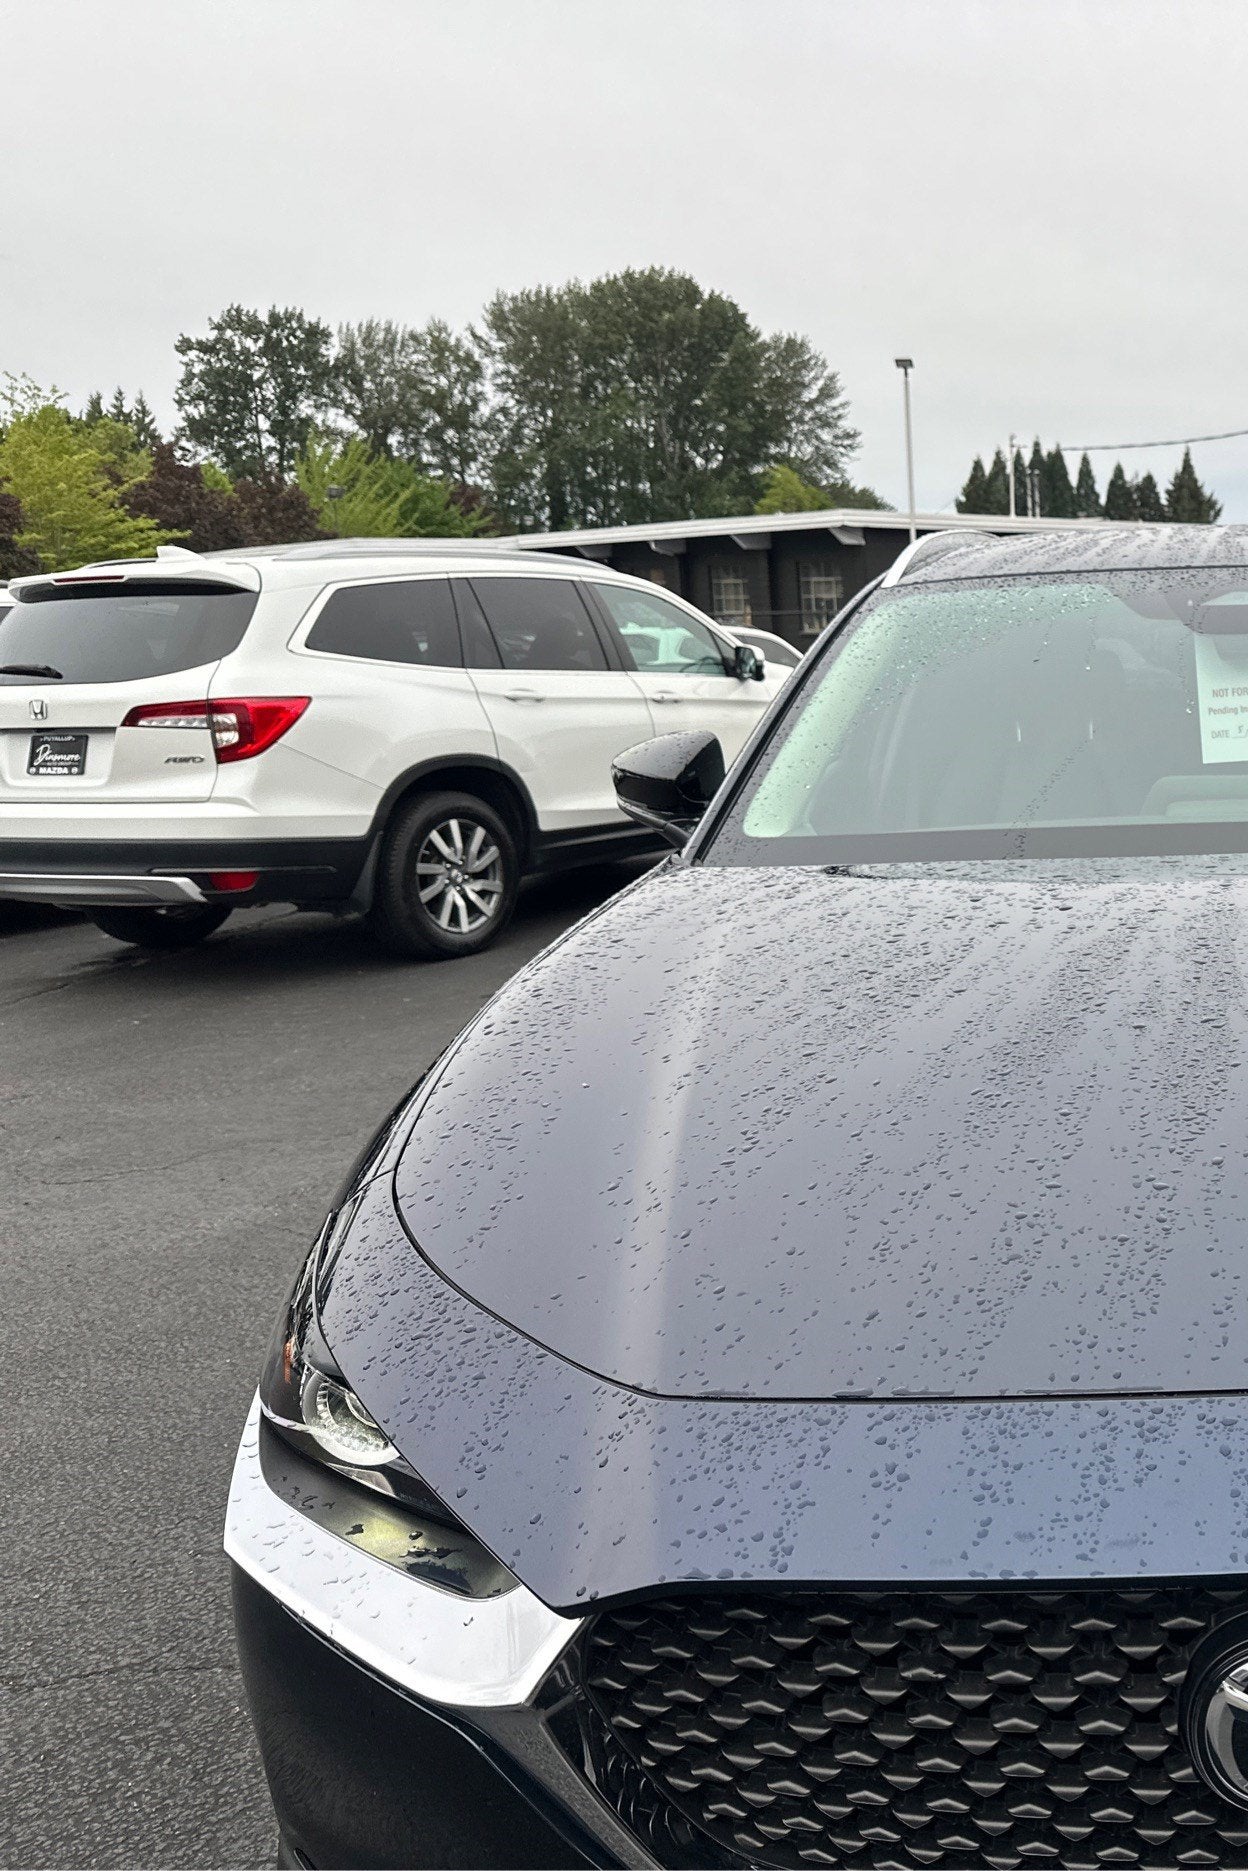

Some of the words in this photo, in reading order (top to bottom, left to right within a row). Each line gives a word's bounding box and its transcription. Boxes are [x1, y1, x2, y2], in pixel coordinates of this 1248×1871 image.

[1212, 688, 1229, 698] NOT
[1232, 687, 1248, 697] FOR
[1208, 706, 1238, 716] Pending
[1211, 730, 1230, 739] DATE
[39, 766, 69, 774] MAZDA
